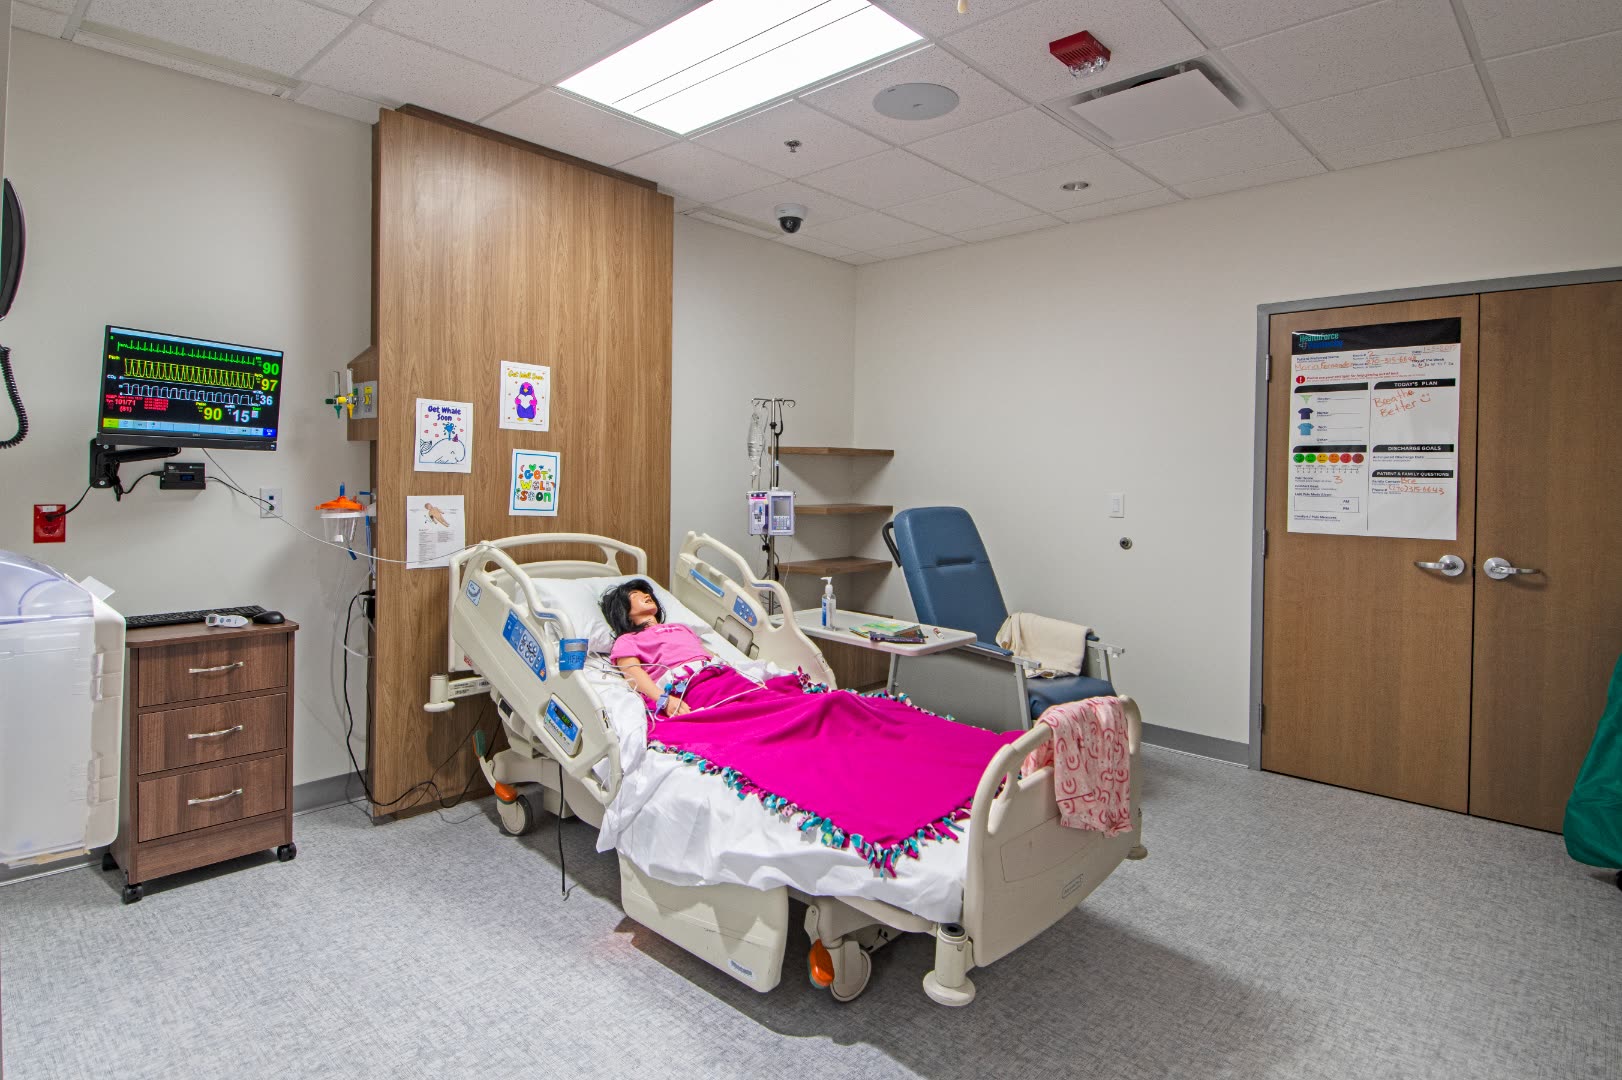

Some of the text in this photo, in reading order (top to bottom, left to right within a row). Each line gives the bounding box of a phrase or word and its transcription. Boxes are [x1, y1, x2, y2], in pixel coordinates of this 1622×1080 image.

[263, 362, 279, 375] 90
[508, 369, 519, 377] Get
[519, 370, 531, 379] Well
[261, 378, 279, 391] 97
[259, 395, 273, 405] 36
[1372, 389, 1415, 407] Breathe
[204, 407, 222, 421] 90
[428, 405, 461, 415] Get Whale
[1380, 400, 1417, 417] Better
[232, 409, 250, 423] 15
[437, 413, 452, 421] Soon
[1333, 475, 1344, 484] 3
